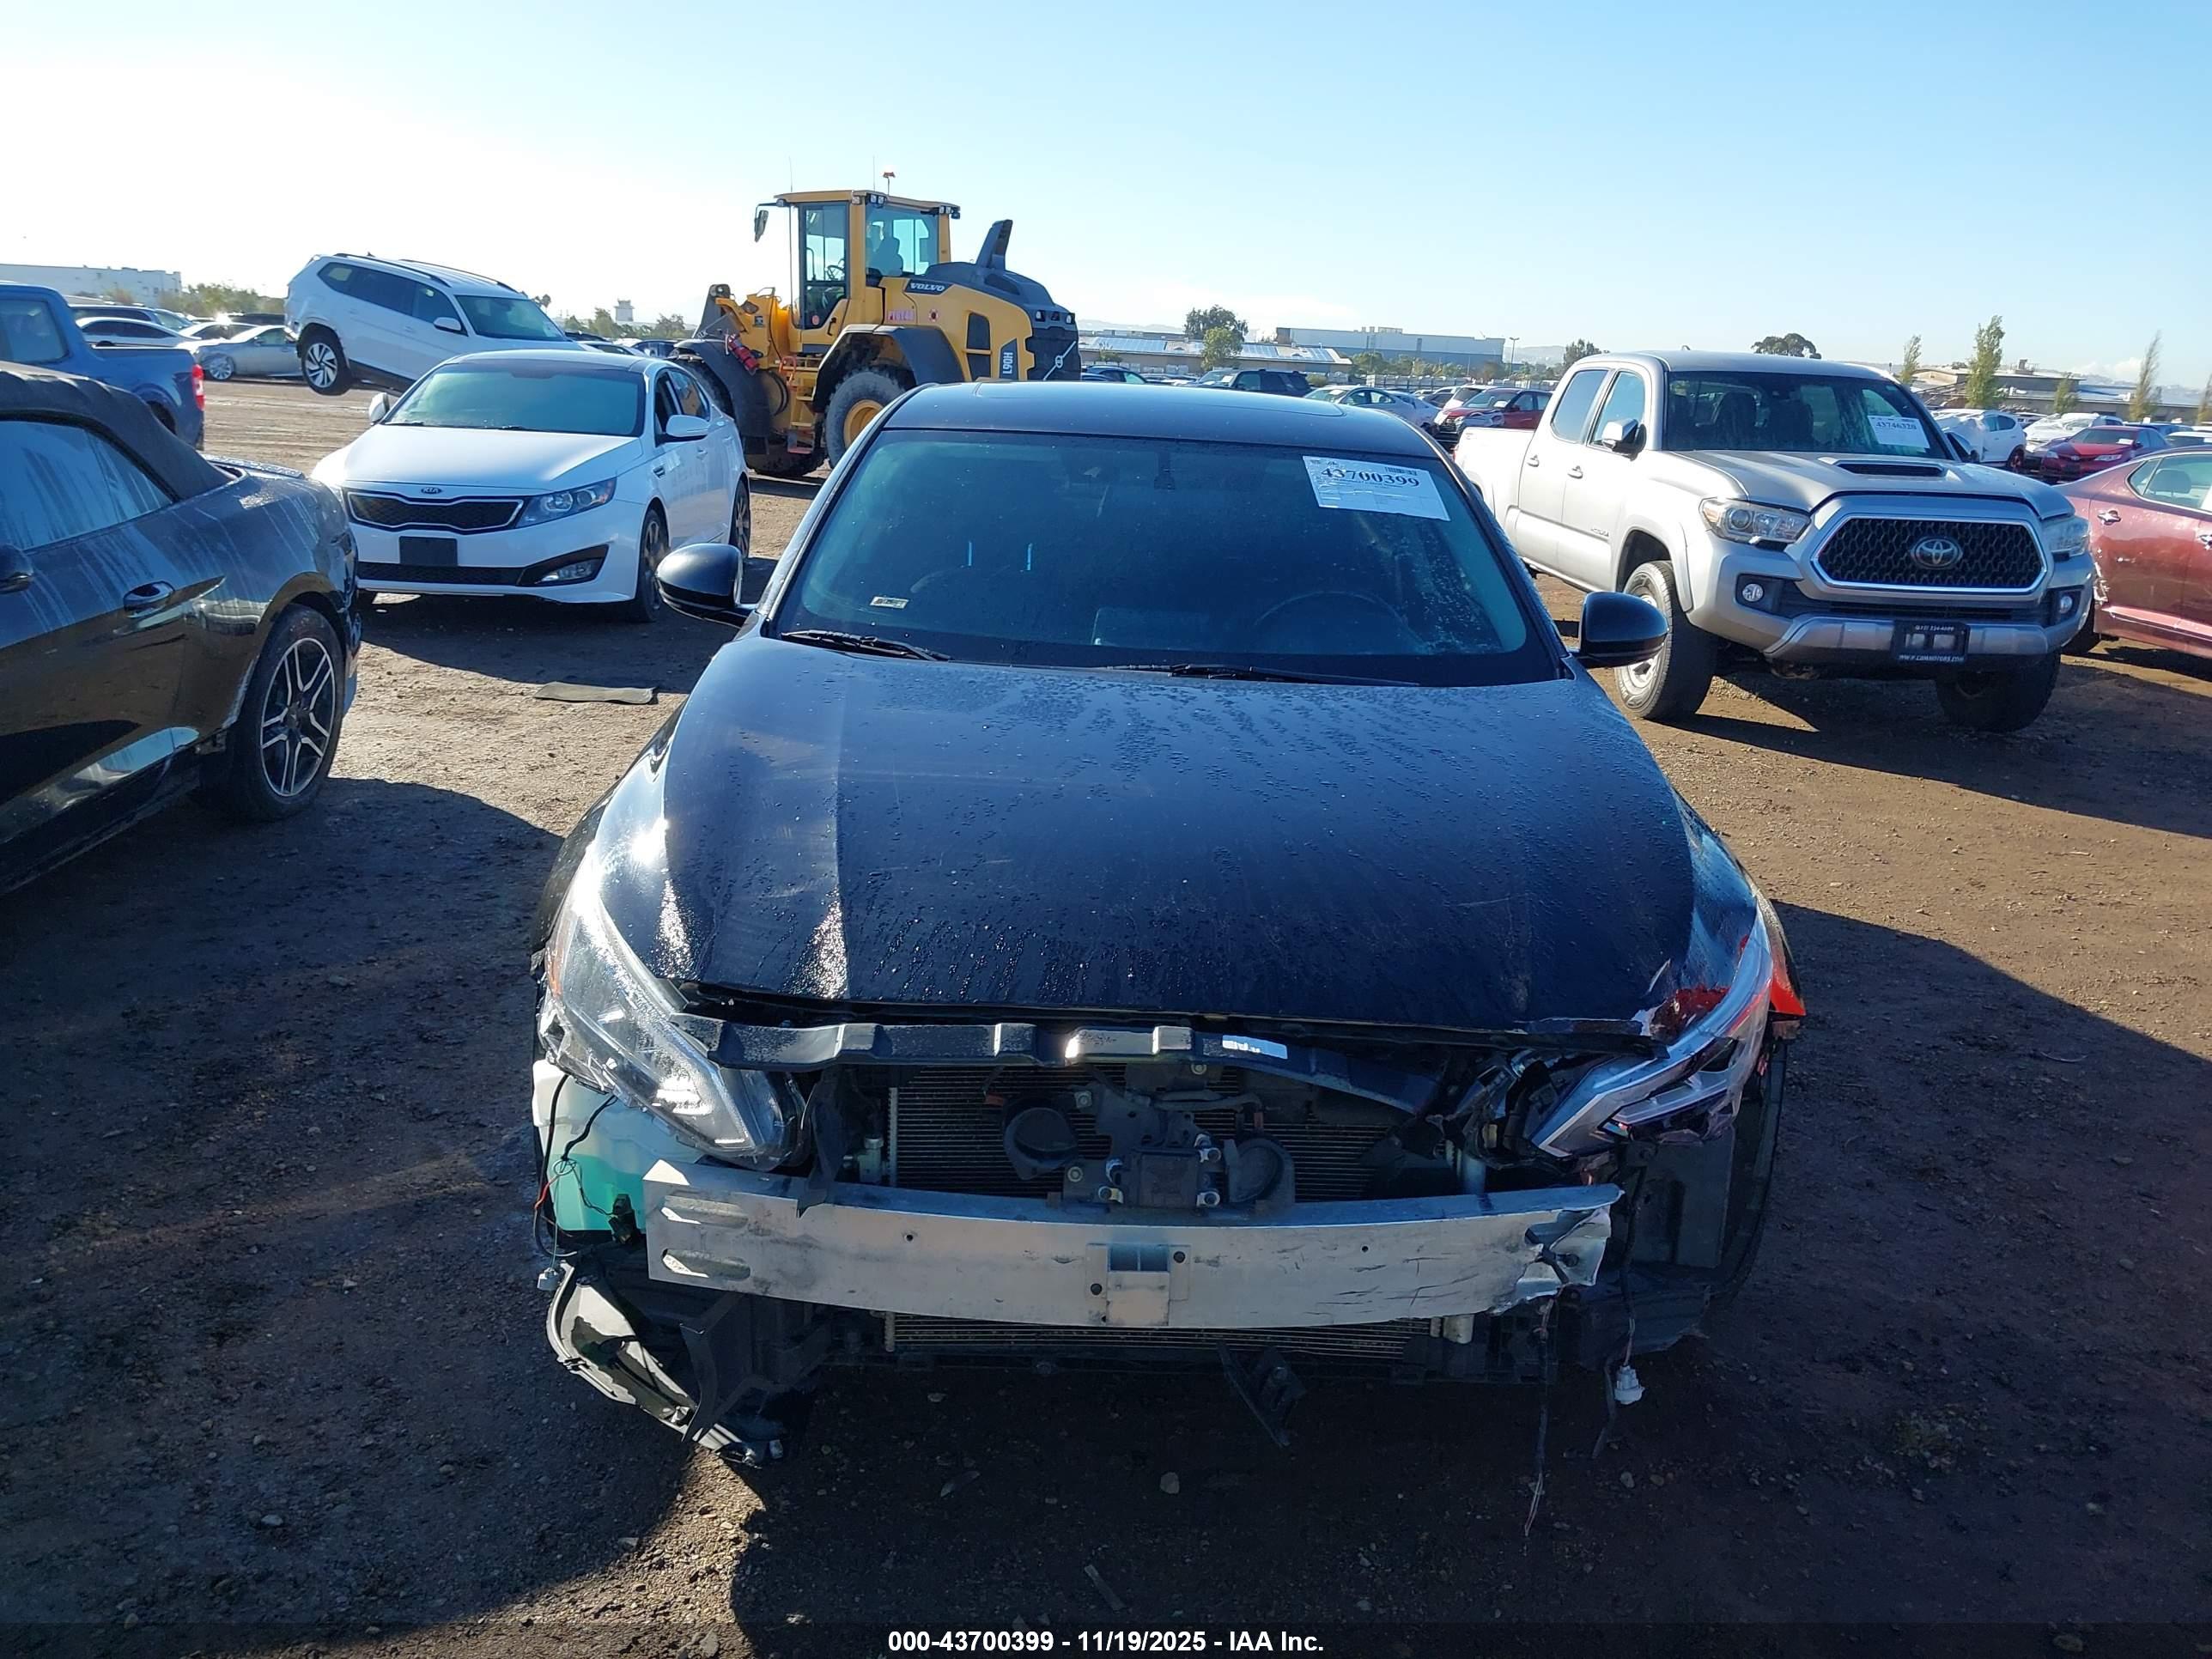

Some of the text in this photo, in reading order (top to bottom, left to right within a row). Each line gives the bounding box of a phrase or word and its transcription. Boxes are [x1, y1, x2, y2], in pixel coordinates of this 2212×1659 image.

[910, 283, 945, 292] VOLVO
[1002, 352, 1013, 374] L90H
[1321, 467, 1420, 488] 43700399
